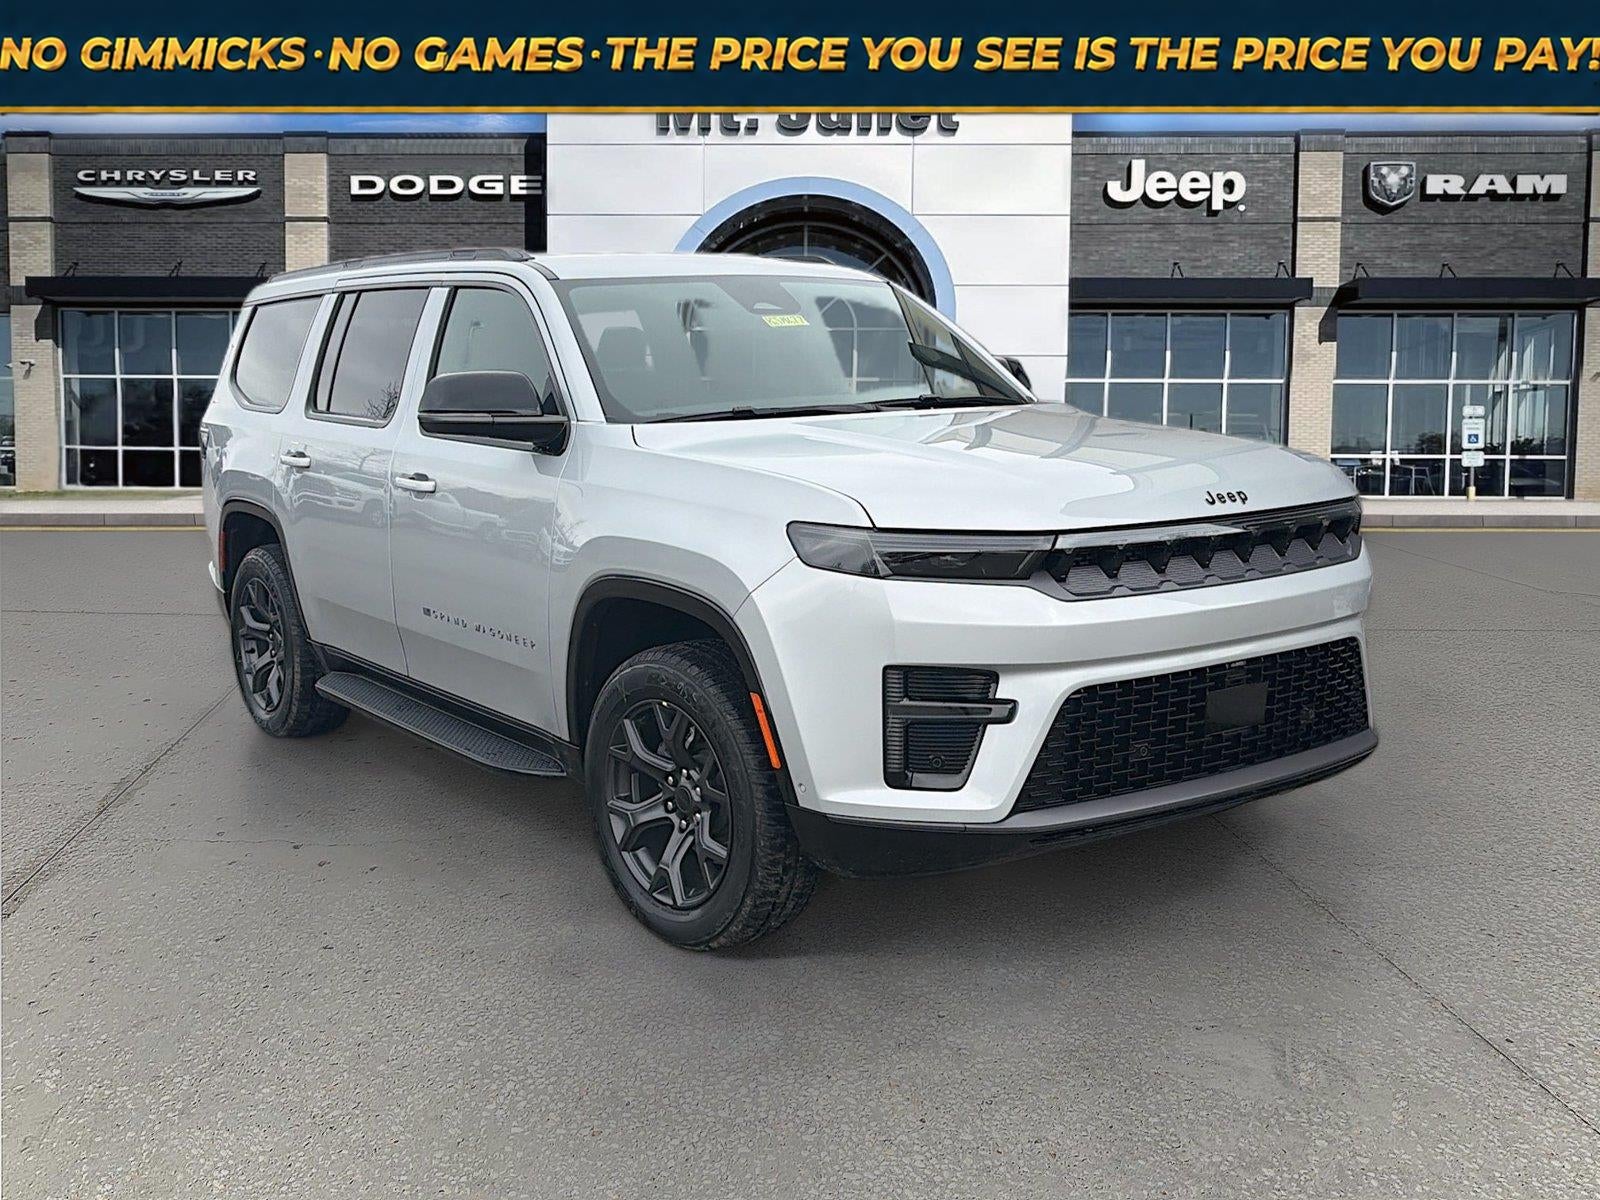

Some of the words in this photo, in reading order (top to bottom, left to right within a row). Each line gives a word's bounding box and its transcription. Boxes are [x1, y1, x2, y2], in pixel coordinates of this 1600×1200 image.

[76, 169, 257, 183] CHRYSLER
[350, 174, 543, 196] DODGE
[1106, 159, 1247, 211] Jeep
[1425, 173, 1568, 195] RAM
[1205, 490, 1249, 506] Jeep
